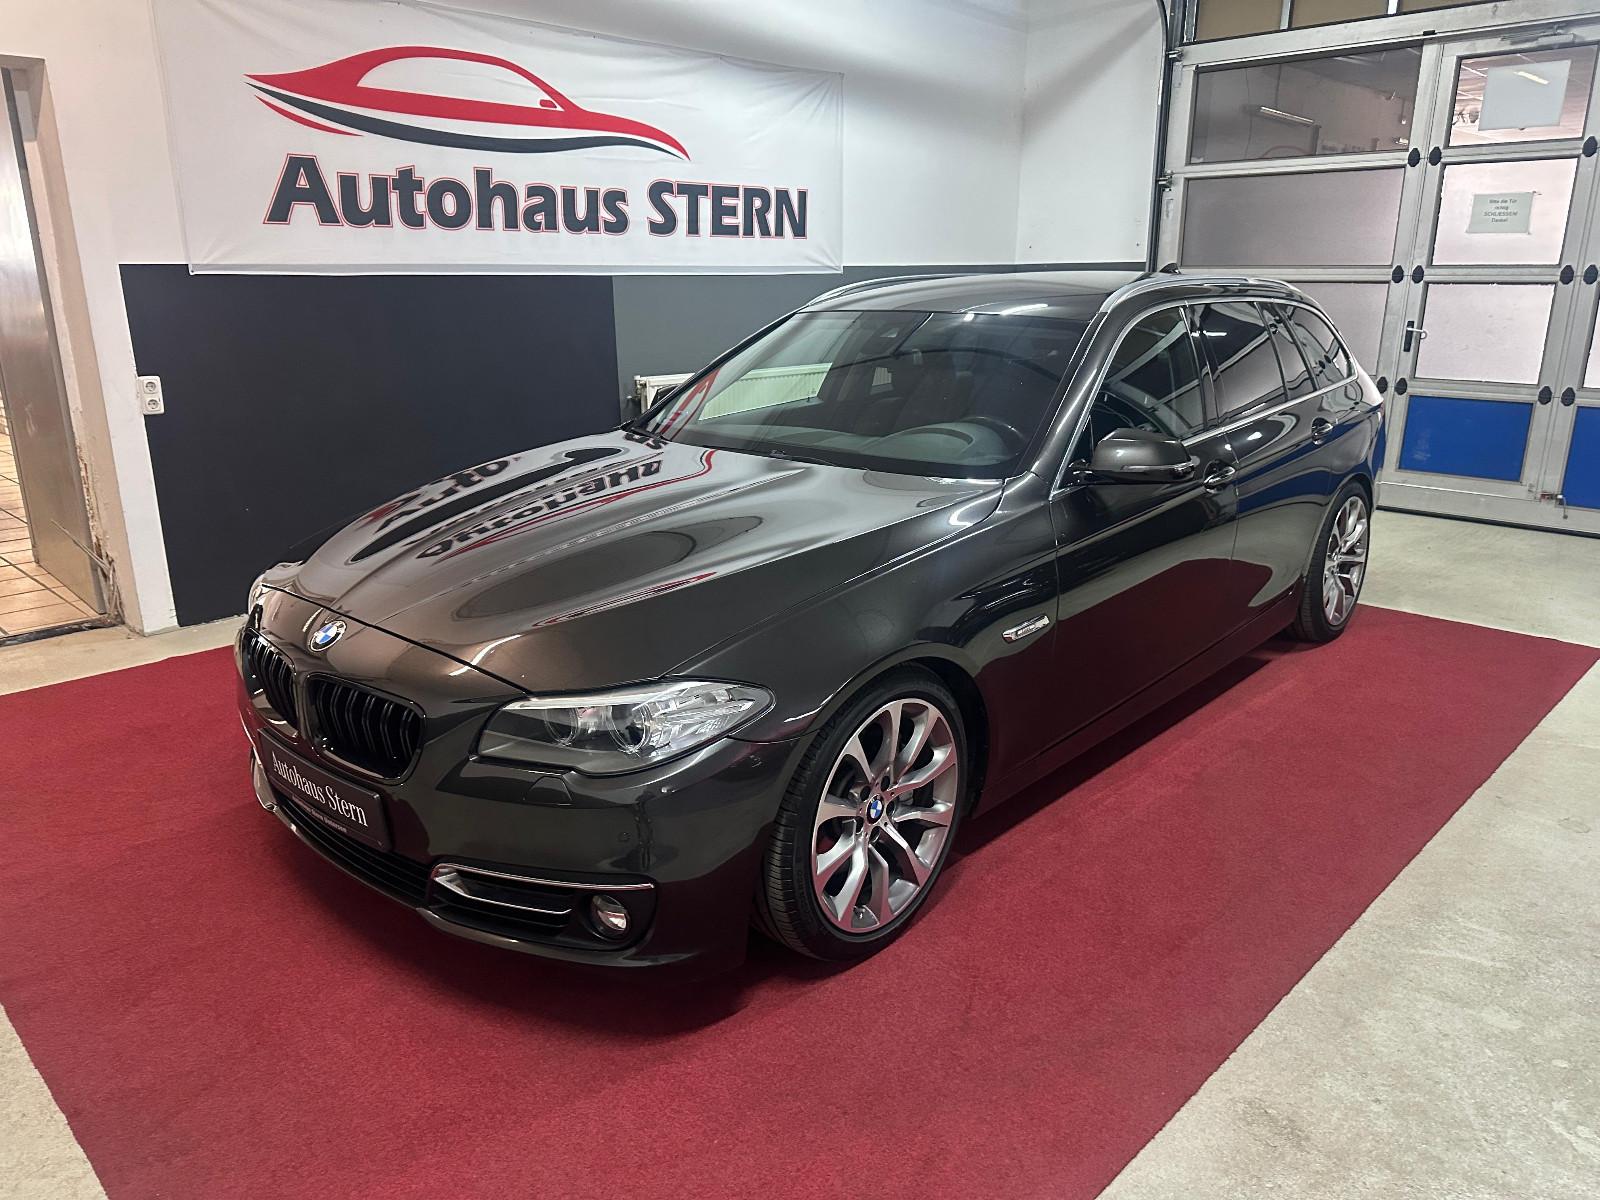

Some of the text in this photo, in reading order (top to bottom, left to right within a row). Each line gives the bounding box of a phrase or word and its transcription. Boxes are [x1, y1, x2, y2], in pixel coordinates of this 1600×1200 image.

[263, 153, 809, 239] Autohaus STERN
[272, 750, 325, 804] Autohaus
[325, 785, 368, 827] Stern
